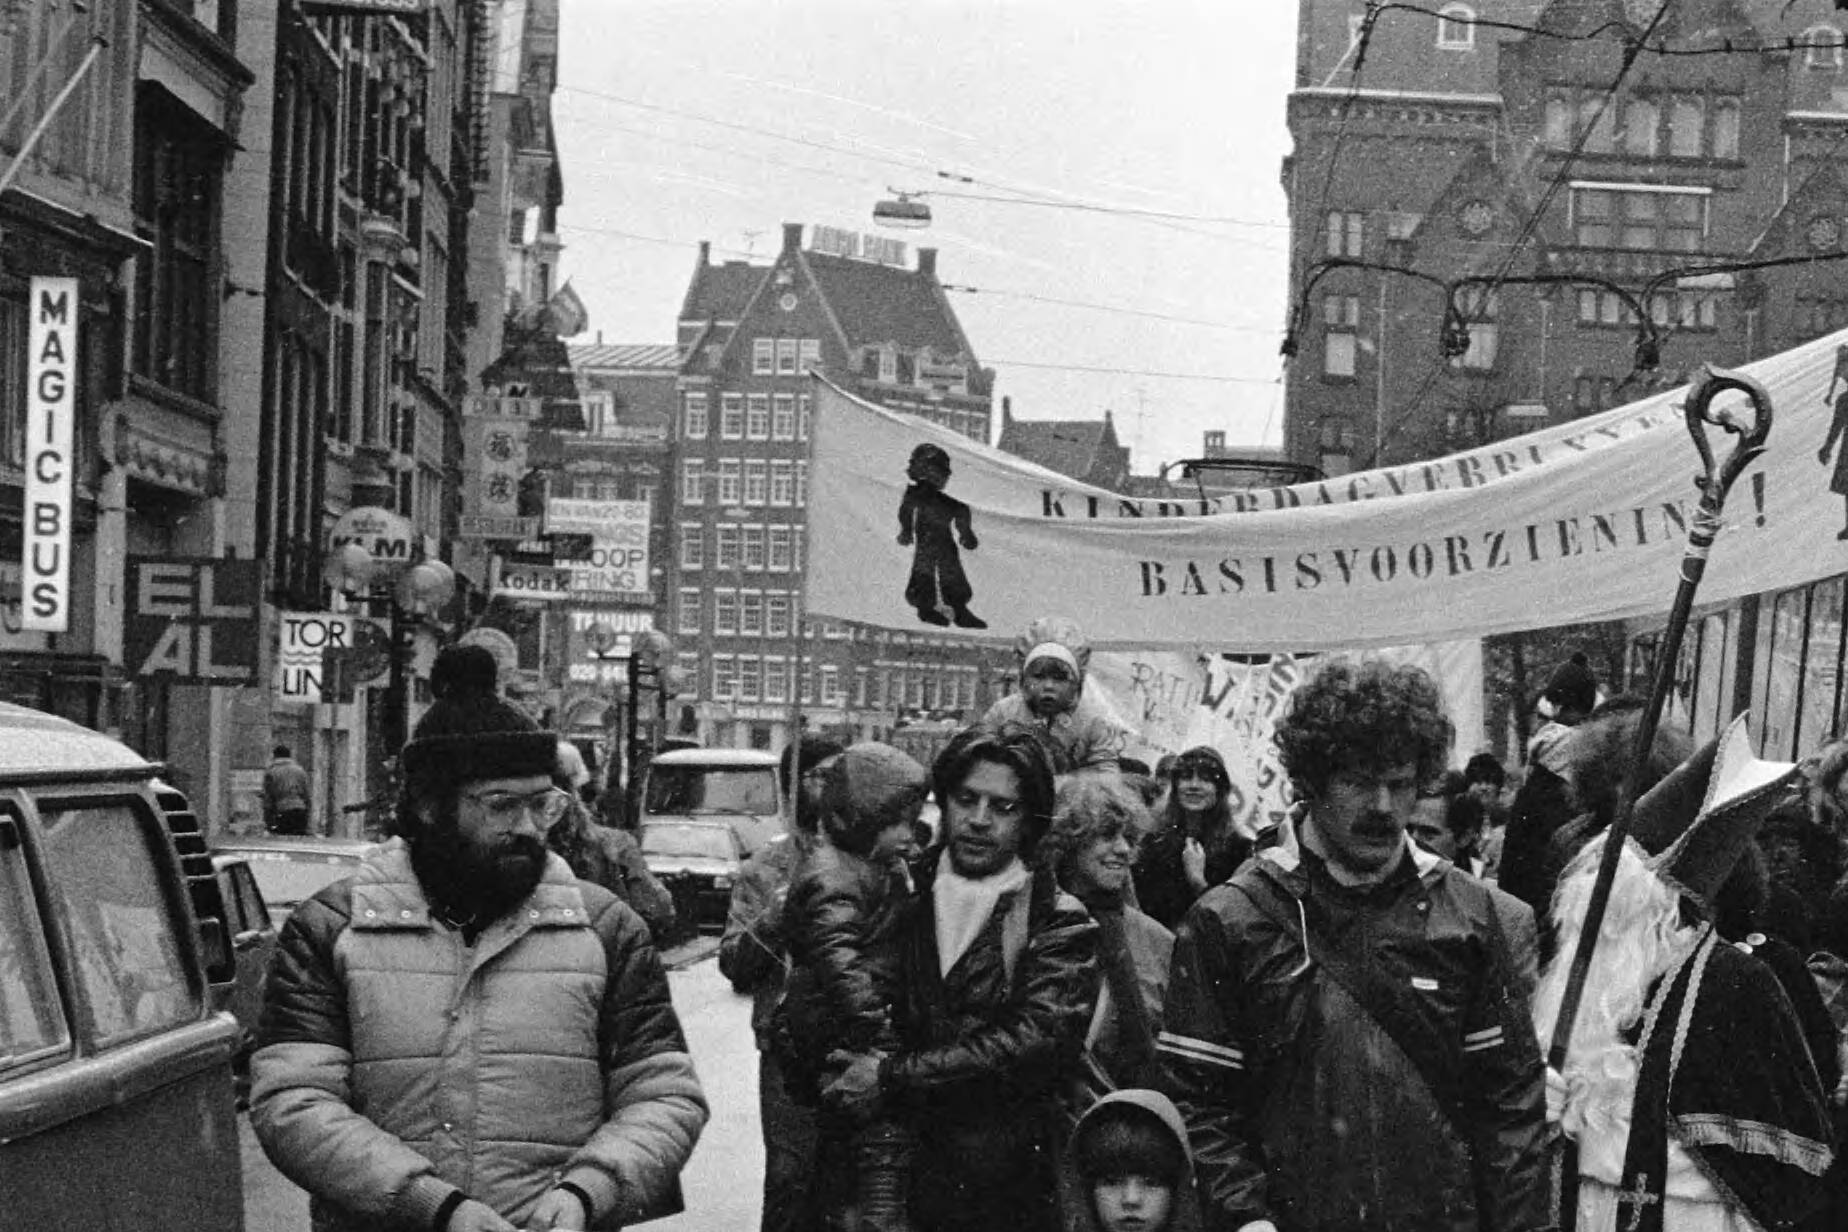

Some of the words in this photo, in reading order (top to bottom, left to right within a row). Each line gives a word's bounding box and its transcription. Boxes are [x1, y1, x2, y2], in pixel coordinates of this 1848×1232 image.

[36, 288, 68, 485] MAGIC
[31, 502, 62, 618] BUS
[1138, 470, 1767, 597] BASISVOORZIENIN!
[138, 563, 253, 618] EL
[139, 623, 252, 679] AL
[284, 618, 346, 649] TOR
[282, 668, 324, 696] LIN
